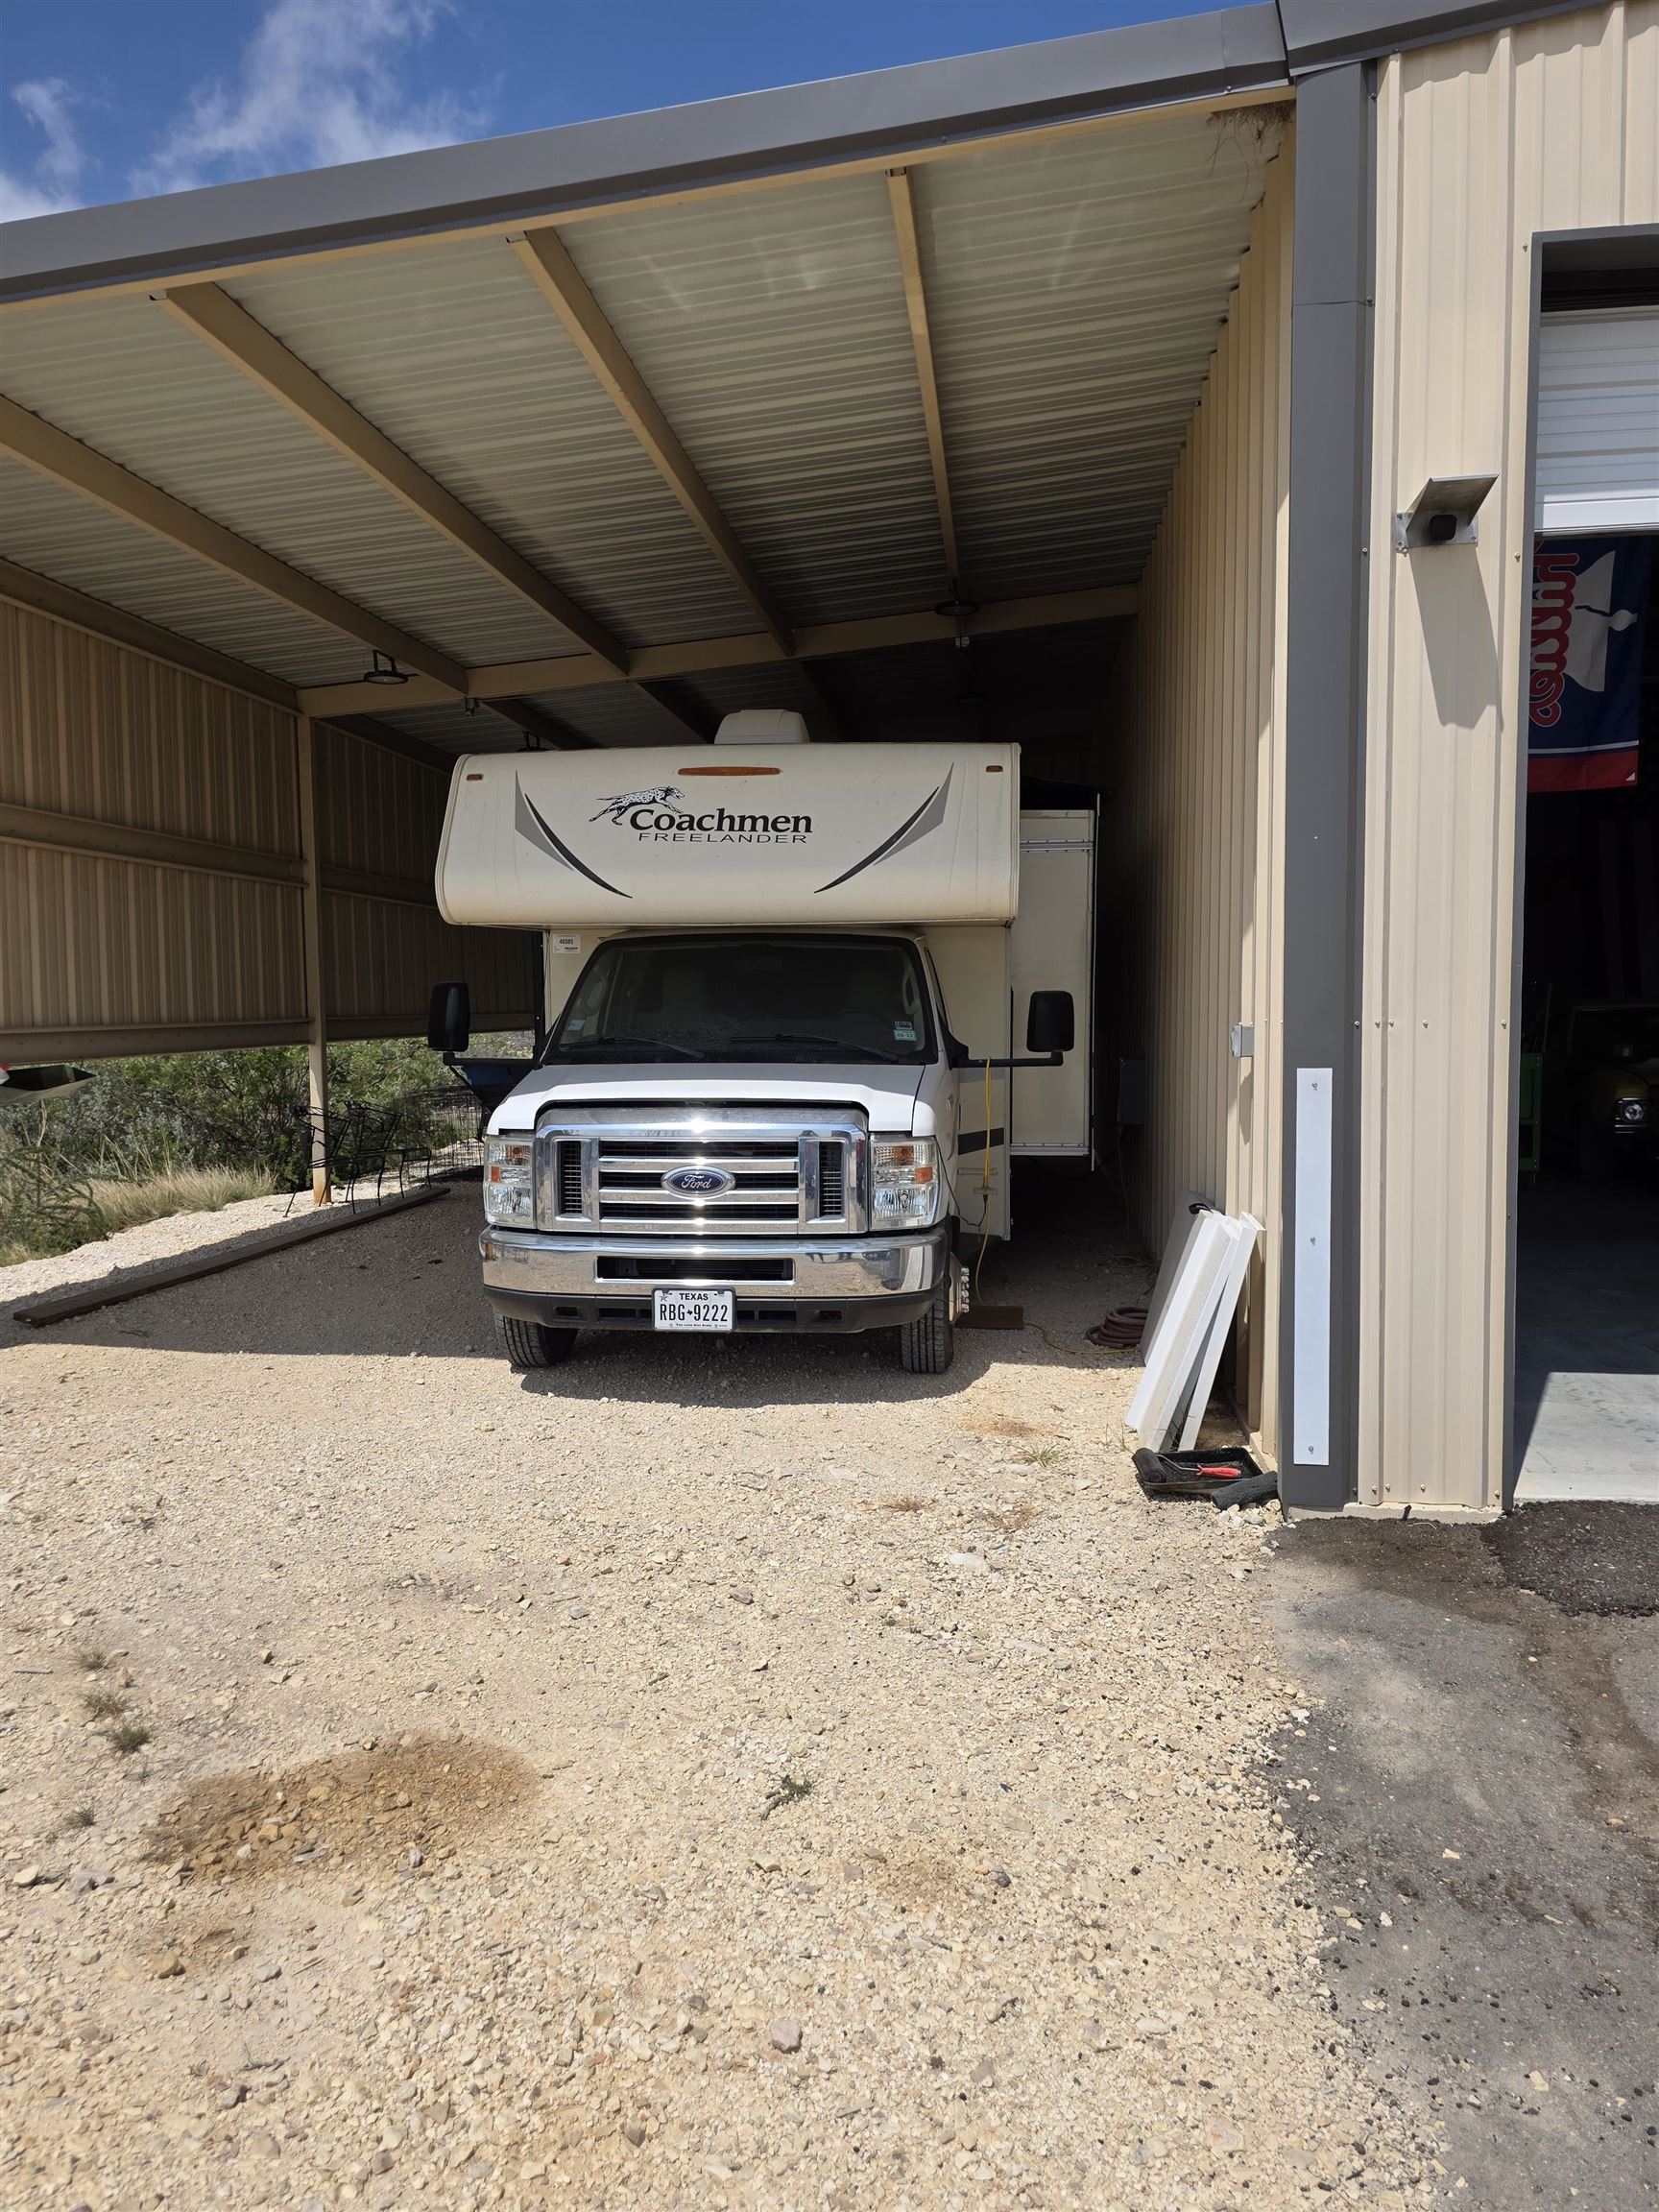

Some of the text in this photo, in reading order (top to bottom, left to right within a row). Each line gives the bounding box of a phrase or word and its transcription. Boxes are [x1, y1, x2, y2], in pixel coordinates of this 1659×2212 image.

[630, 807, 813, 833] Coachmen
[638, 832, 807, 844] FREELANDER
[681, 1174, 712, 1189] Ford
